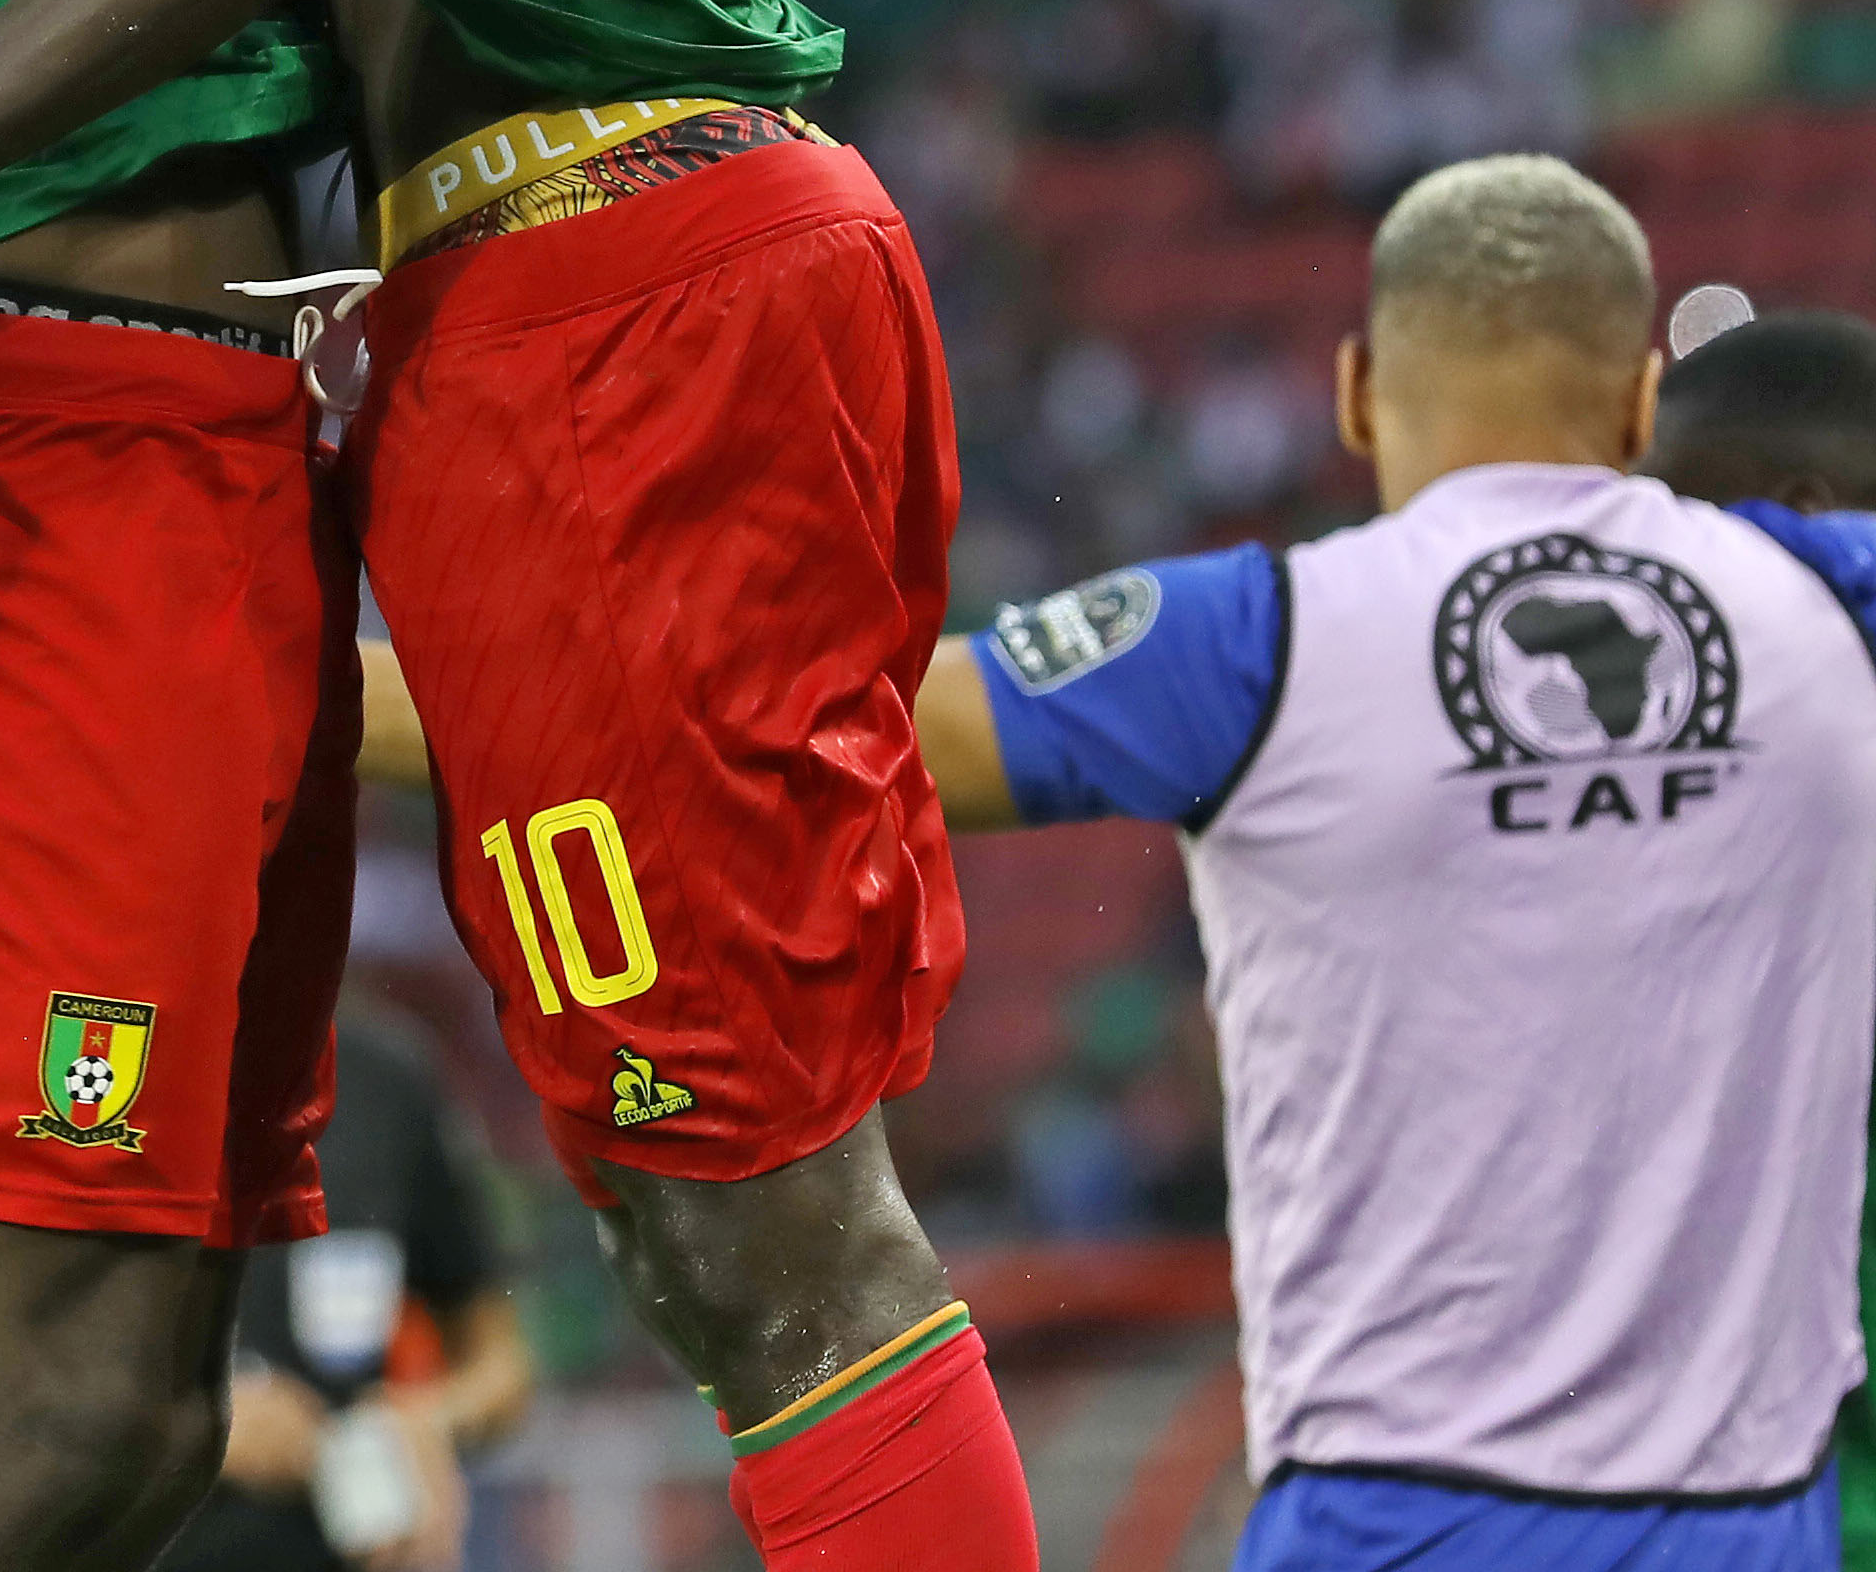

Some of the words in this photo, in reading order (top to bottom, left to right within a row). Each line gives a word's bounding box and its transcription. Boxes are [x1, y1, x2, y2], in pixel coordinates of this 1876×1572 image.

[1490, 763, 1718, 834] CAF
[480, 798, 659, 1016] 10
[58, 998, 147, 1023] CAMEROUN
[649, 1095, 693, 1118] SPORTIF
